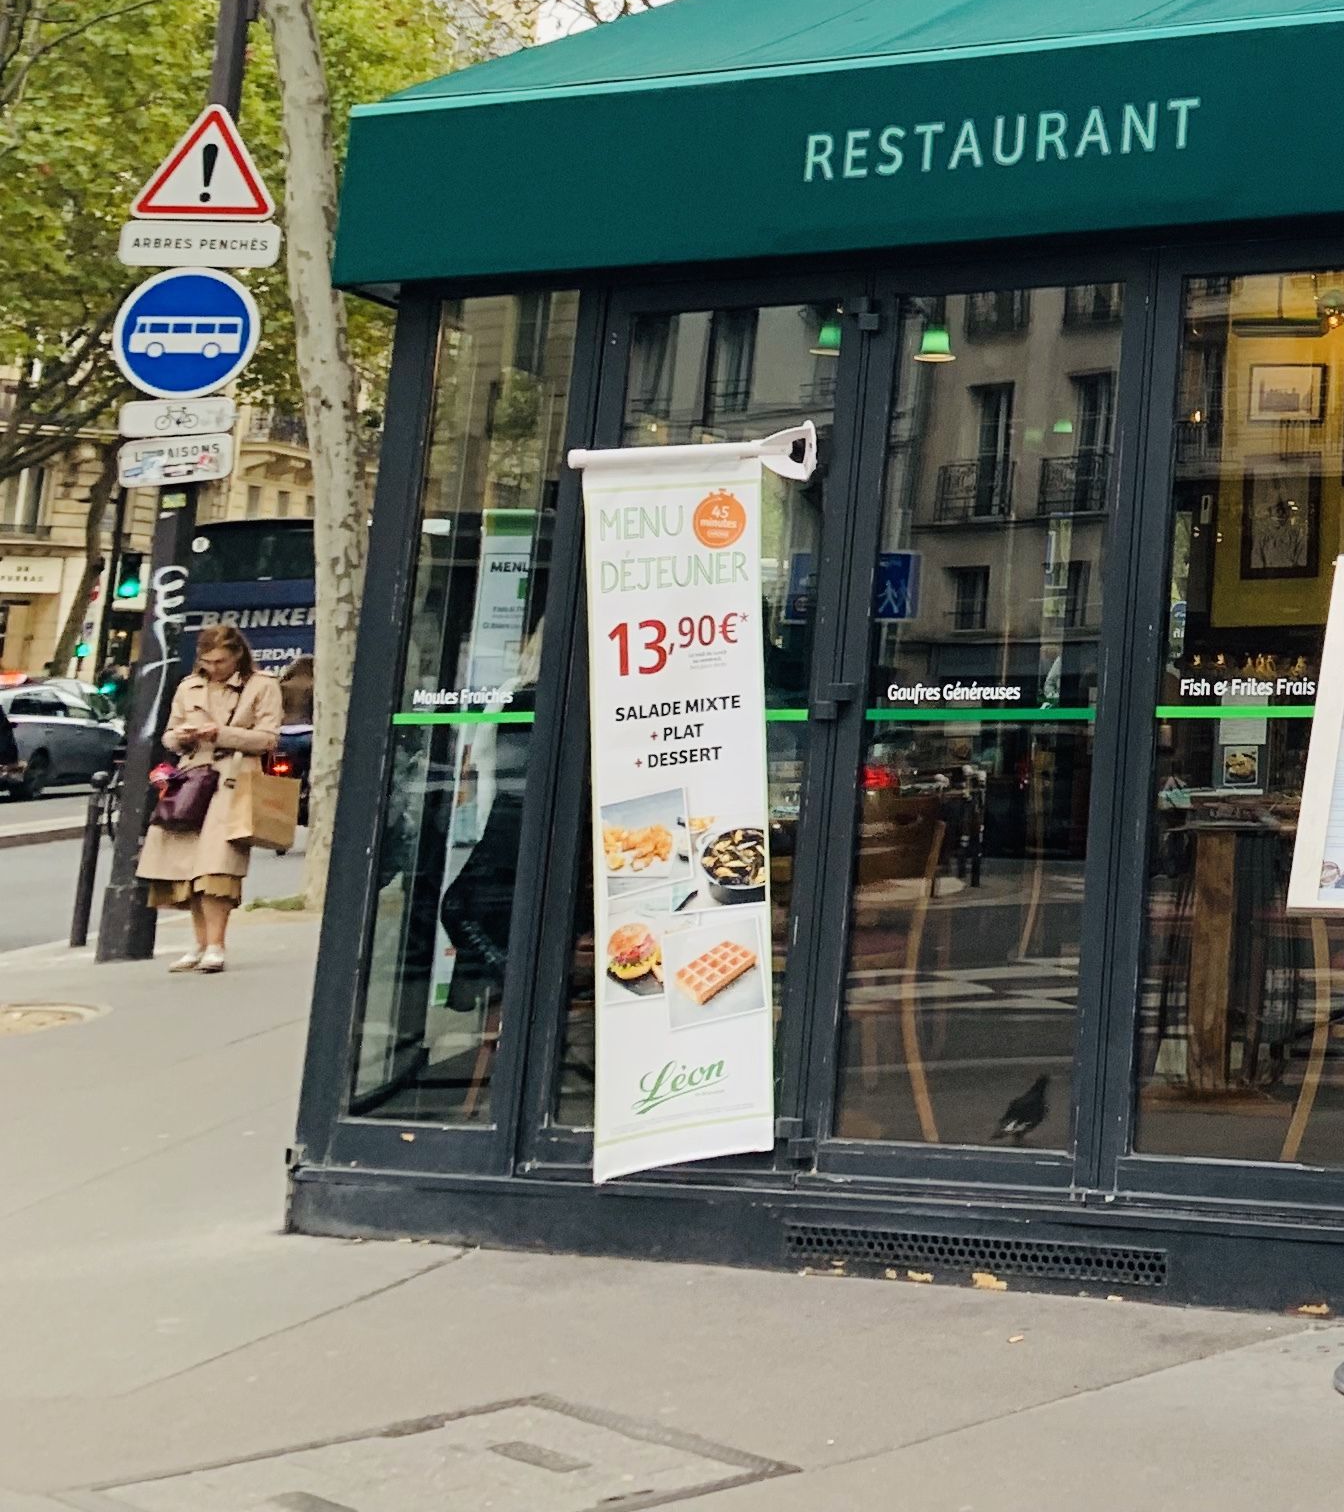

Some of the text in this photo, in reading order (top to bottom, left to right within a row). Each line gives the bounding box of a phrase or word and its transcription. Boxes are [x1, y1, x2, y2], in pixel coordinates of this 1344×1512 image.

[803, 96, 1200, 182] RESTAURANT
[132, 237, 269, 251] ARBRES PENCHÉS
[135, 443, 220, 462] LAISONS
[711, 505, 730, 519] 45
[599, 504, 684, 542] MENU
[700, 518, 737, 529] minutes
[600, 550, 749, 595] DÉJEUNER
[412, 686, 514, 705] Moules Fraîches
[887, 680, 1021, 705] Gaufres Généreuses
[1180, 677, 1316, 697] Fish & Frites Frais
[615, 695, 741, 722] SALADE MIXTE
[663, 723, 704, 741] PLAT
[648, 746, 722, 769] DESSERT
[632, 1059, 729, 1115] Léon
